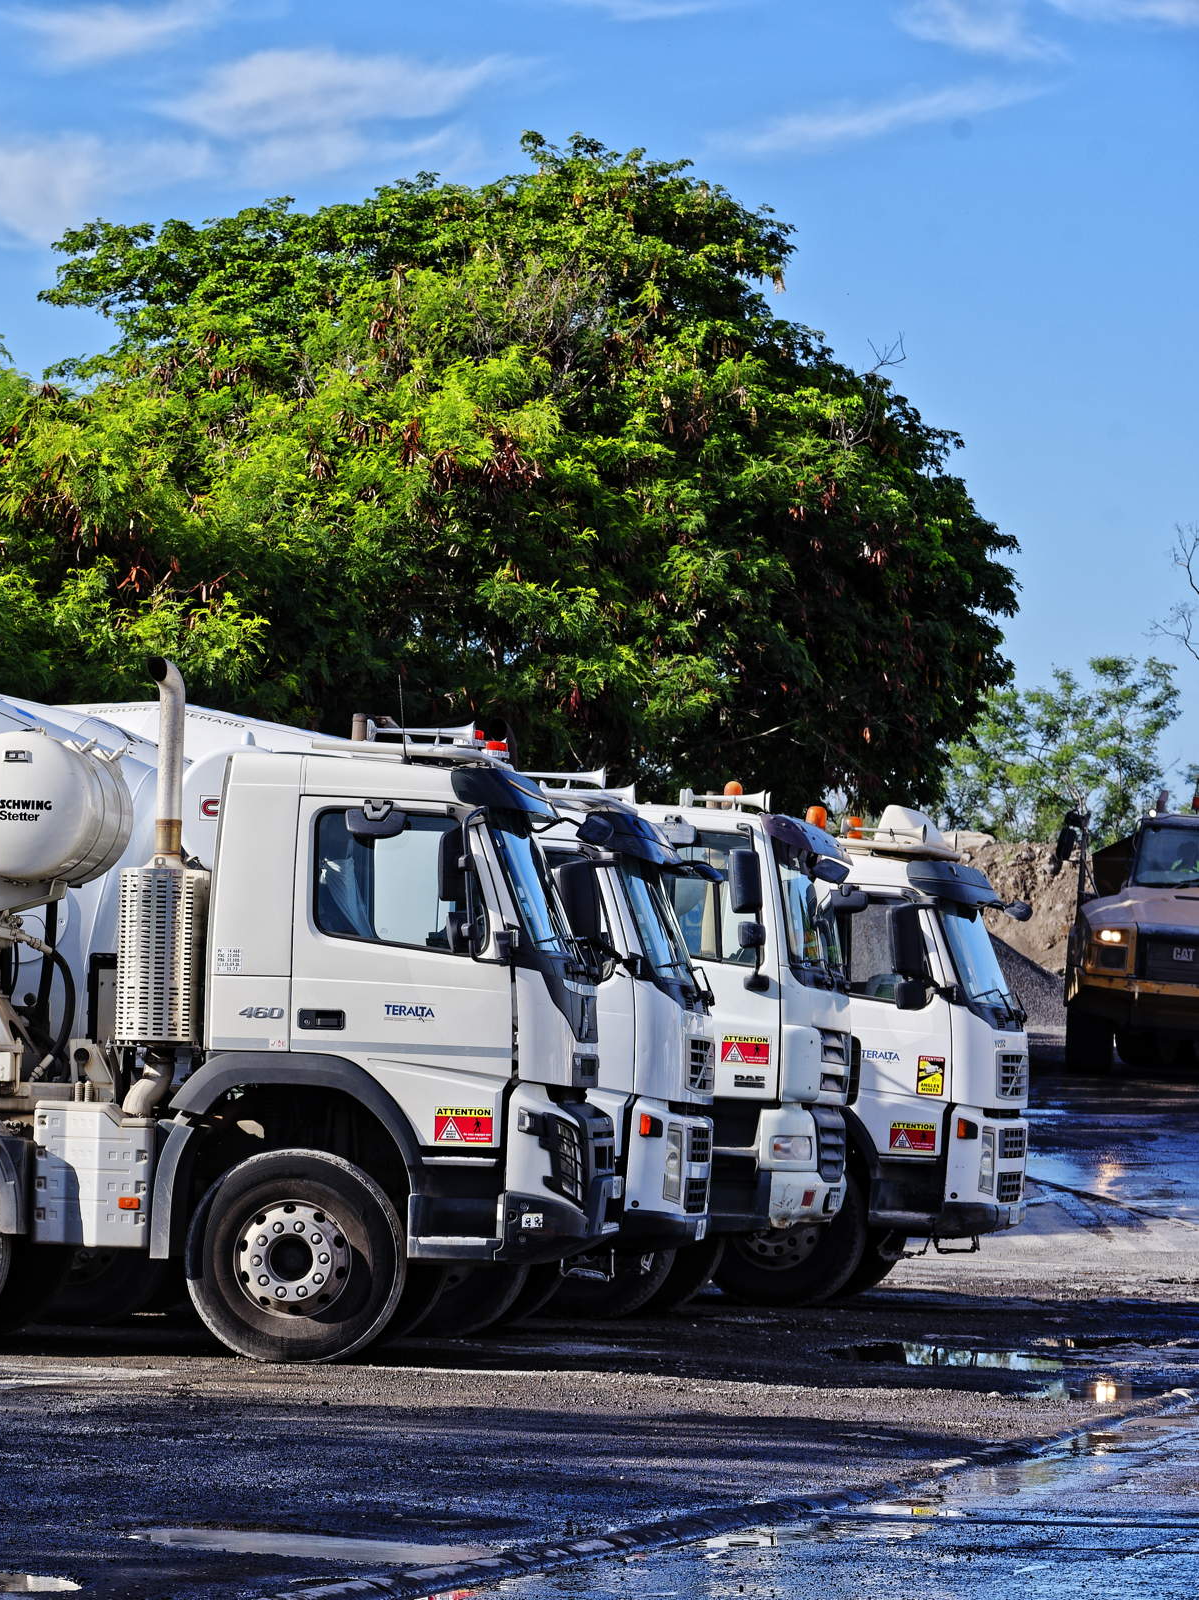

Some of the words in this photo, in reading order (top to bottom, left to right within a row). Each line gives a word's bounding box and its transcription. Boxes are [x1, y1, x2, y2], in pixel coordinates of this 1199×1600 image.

[87, 706, 151, 714] GROUPE
[0, 799, 52, 810] SCHWING
[0, 810, 40, 821] Stetter
[1172, 946, 1196, 962] CAT
[239, 1006, 284, 1019] 460
[384, 1004, 435, 1018] TERALTA
[723, 1035, 769, 1043] ATTENTION
[861, 1049, 900, 1061] TERALTA
[437, 1108, 491, 1116] ATTENTION
[892, 1122, 935, 1130] ATTENTION
